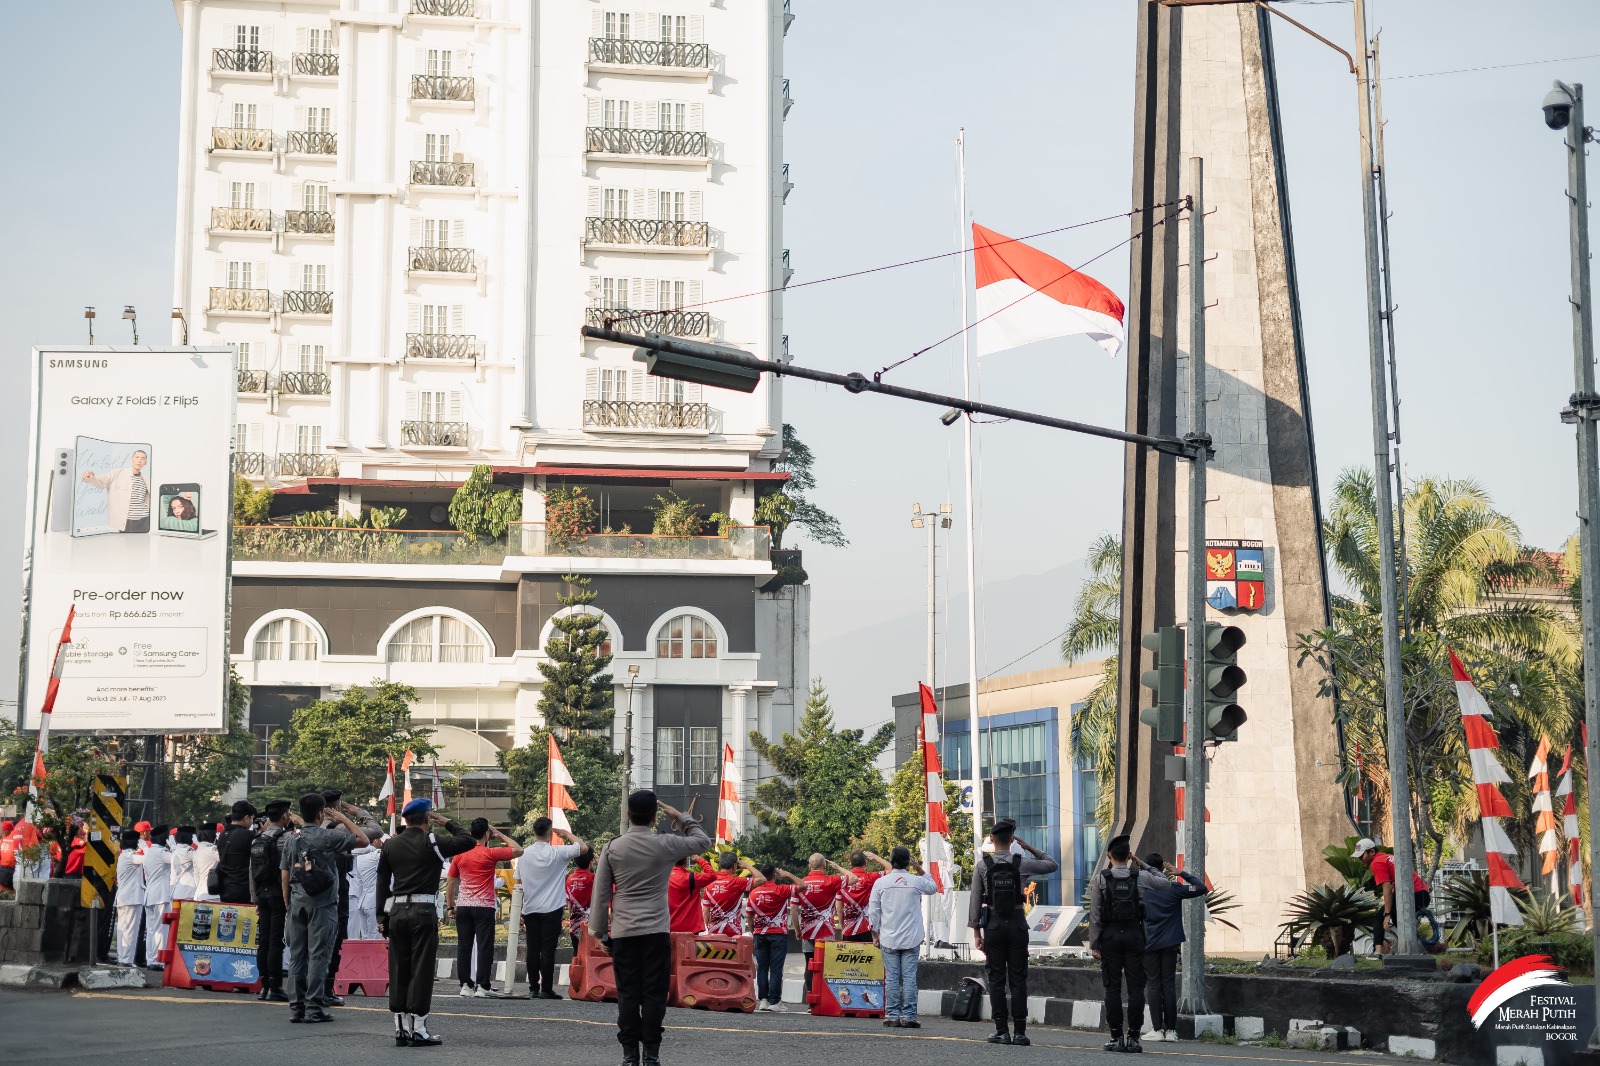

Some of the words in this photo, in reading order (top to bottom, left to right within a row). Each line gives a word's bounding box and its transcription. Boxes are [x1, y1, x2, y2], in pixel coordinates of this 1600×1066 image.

[49, 359, 108, 369] SAMSUNG
[71, 395, 114, 407] Galaxy
[116, 396, 123, 405] Z
[125, 395, 157, 405] Fold5
[163, 396, 171, 405] Z
[173, 395, 199, 408] Flip5
[1242, 540, 1263, 548] BOGOR
[73, 589, 147, 601] Pre-order
[151, 590, 184, 601] now
[109, 610, 121, 620] Rp
[123, 610, 157, 618] 666.625
[133, 642, 152, 650] Free
[83, 651, 114, 659] storage
[143, 650, 177, 659] Samsung
[220, 911, 238, 919] ABC
[835, 954, 875, 964] POWER
